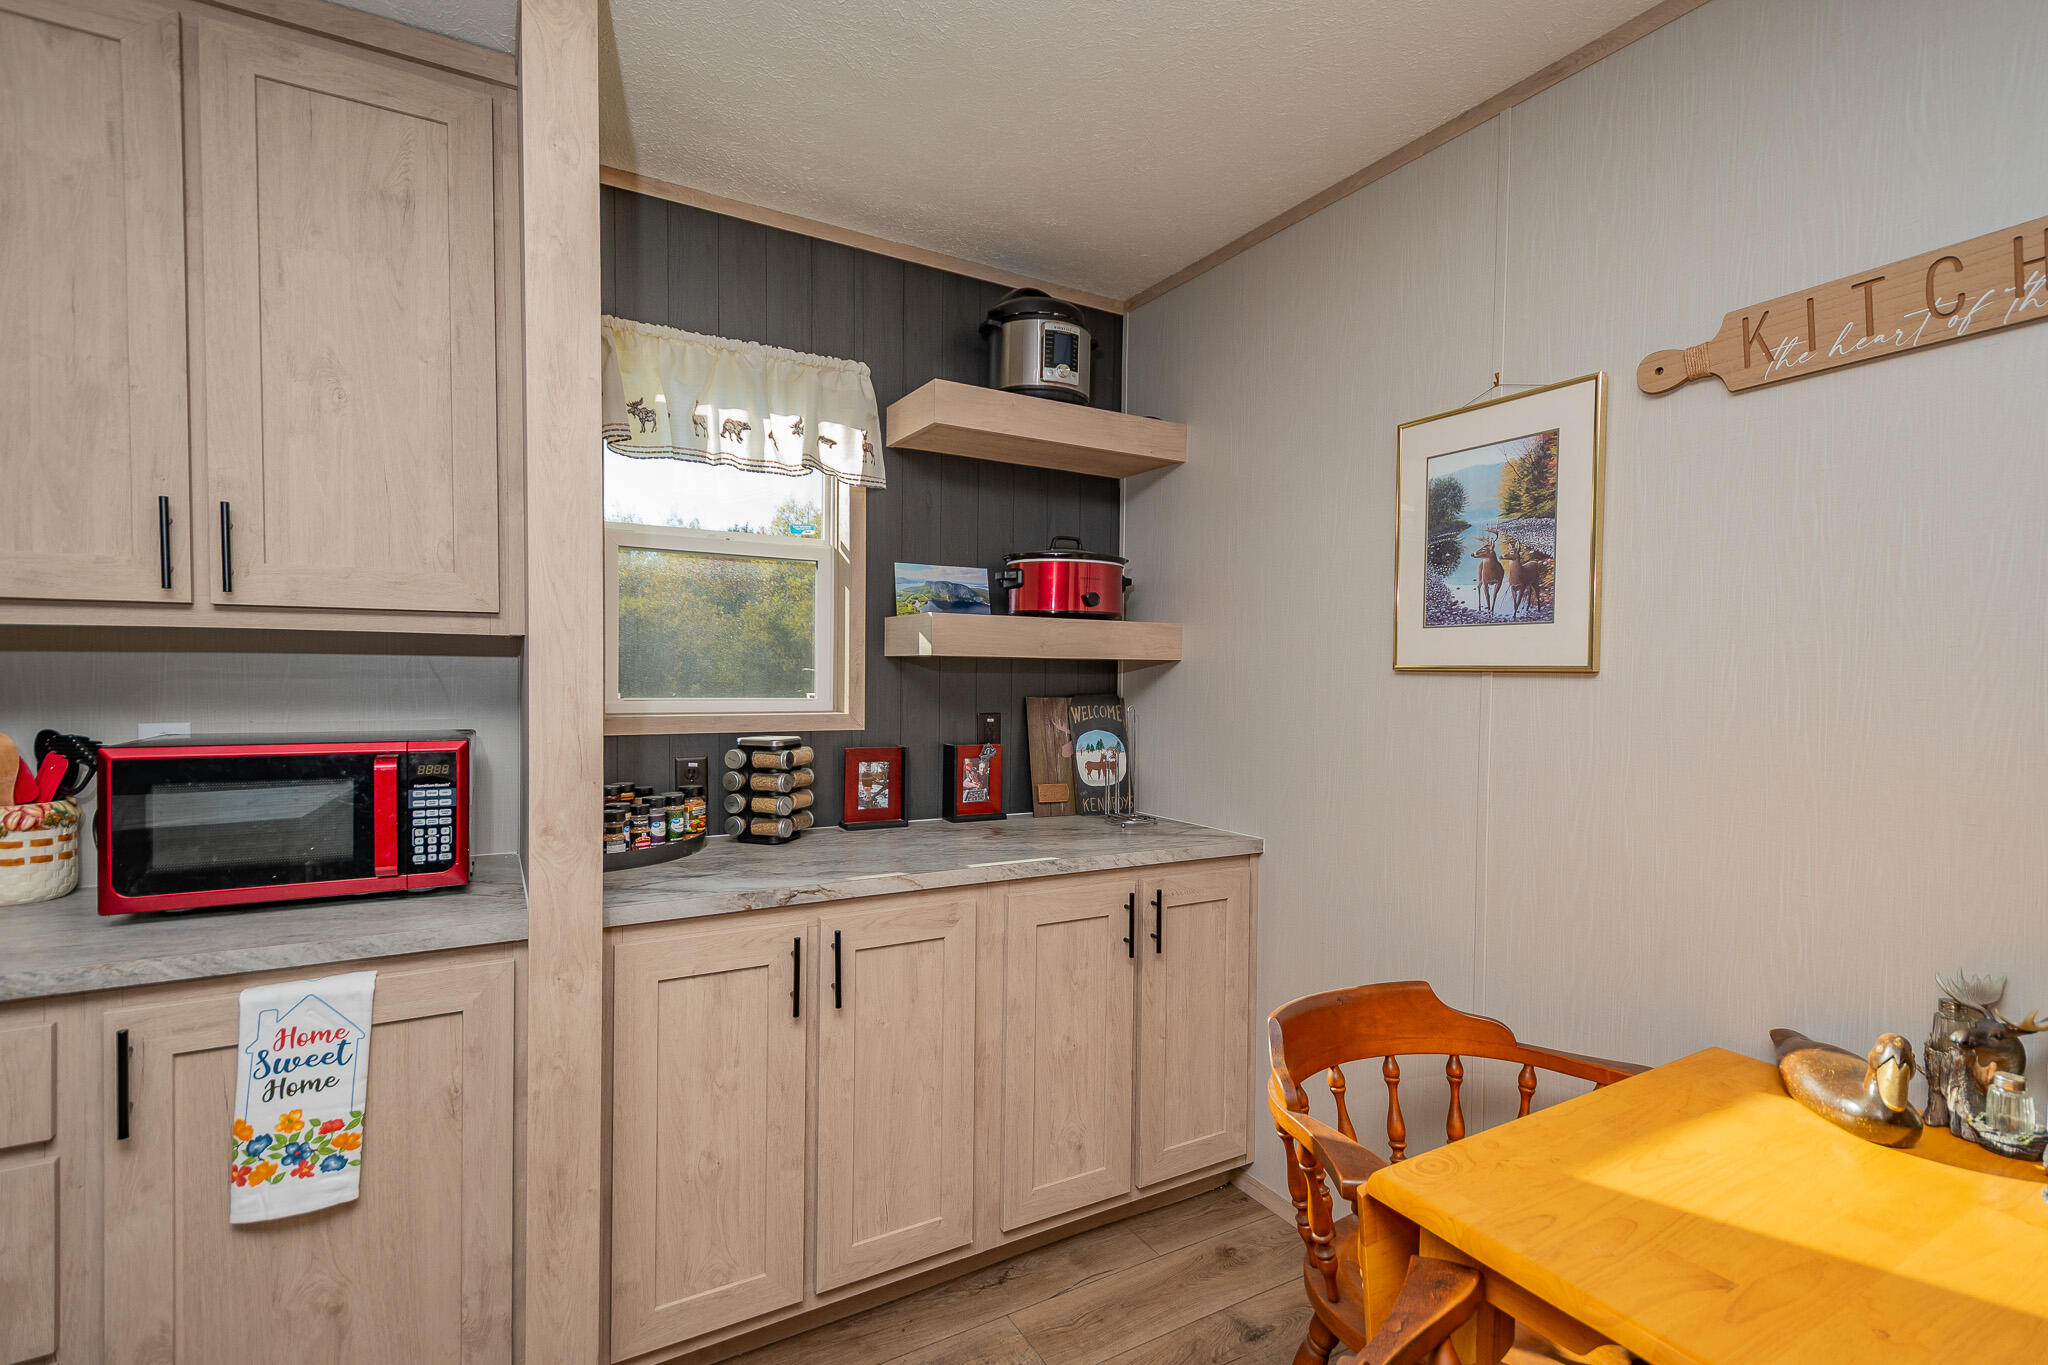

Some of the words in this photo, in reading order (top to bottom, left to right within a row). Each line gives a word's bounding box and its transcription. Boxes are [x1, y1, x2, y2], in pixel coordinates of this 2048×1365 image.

[1741, 227, 2048, 368] KITCH
[1762, 336, 1816, 380] the
[1828, 296, 1975, 358] heart
[1948, 288, 1995, 336] of
[1070, 704, 1123, 724] WELCOME
[273, 1026, 350, 1052] Home
[253, 1039, 353, 1080] Sweet
[262, 1075, 340, 1103] Home
